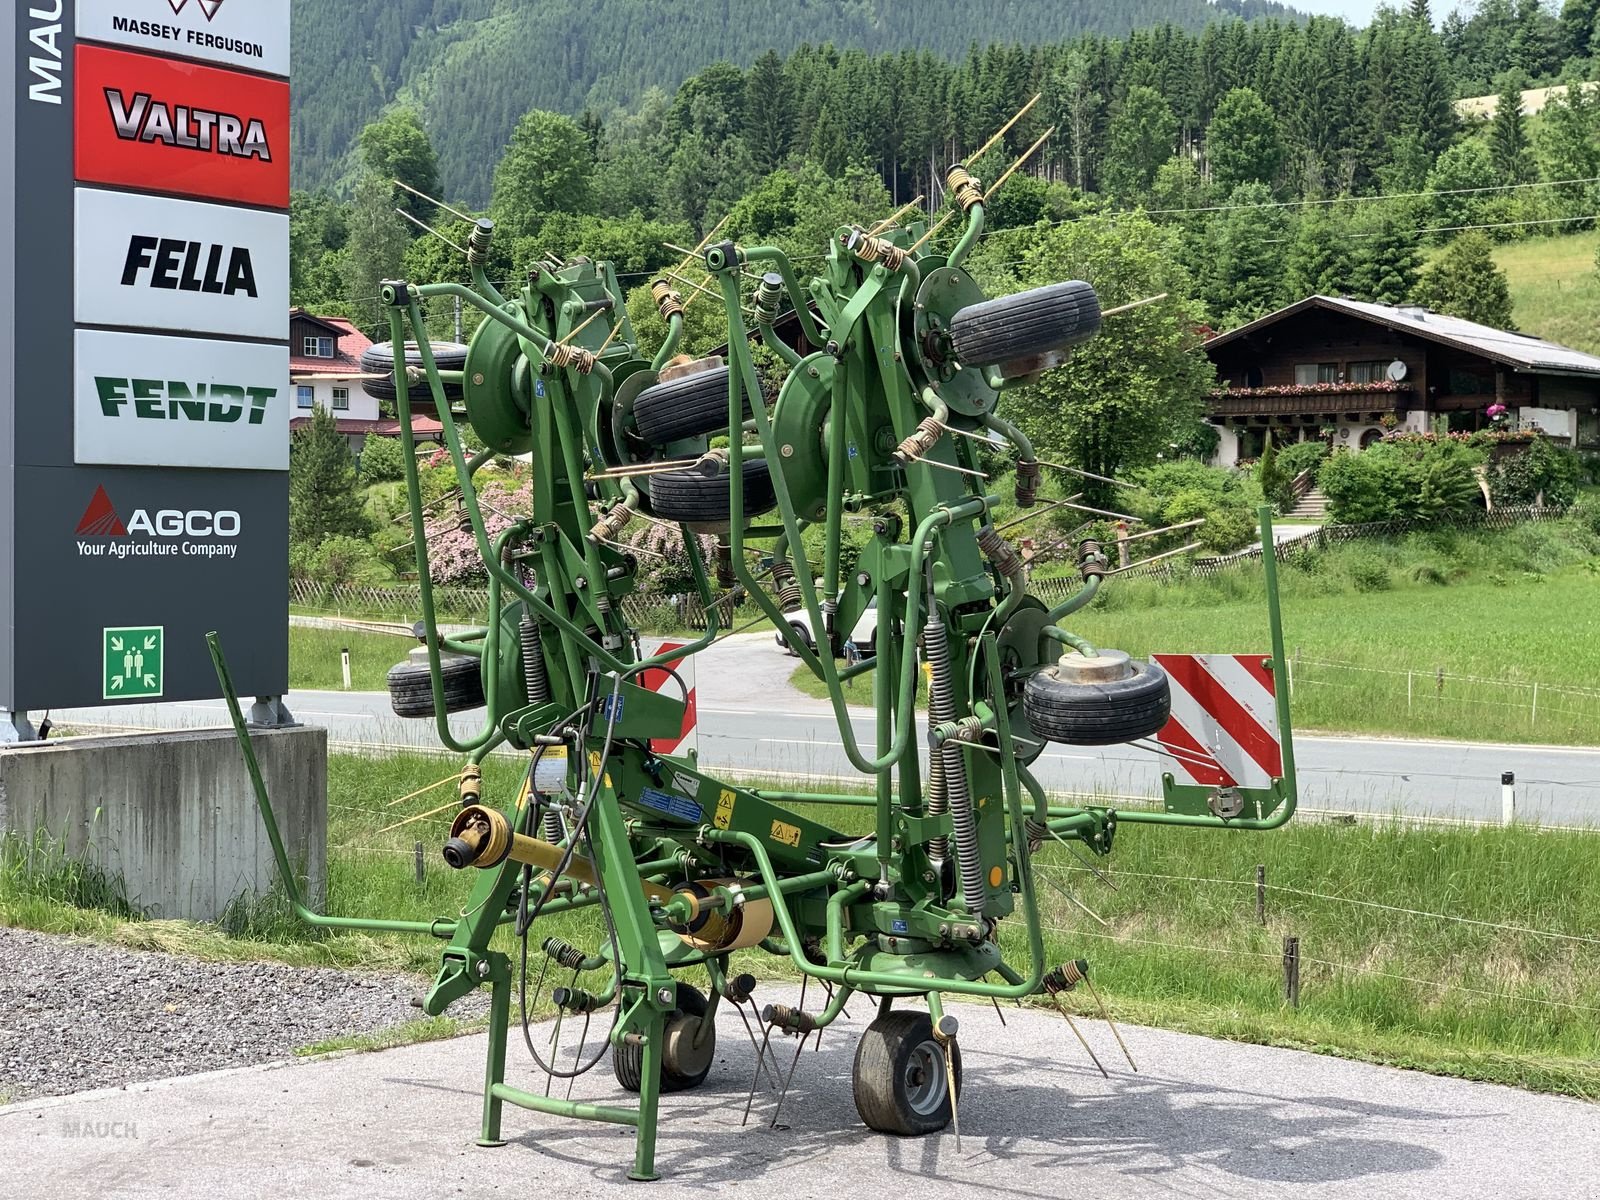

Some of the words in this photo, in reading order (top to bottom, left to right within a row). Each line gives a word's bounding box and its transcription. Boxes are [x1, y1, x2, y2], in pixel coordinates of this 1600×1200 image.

[113, 16, 181, 41] MASSEY
[187, 30, 263, 57] FERGUSON
[103, 87, 272, 163] VALTRA
[120, 235, 258, 298] FELLA
[94, 376, 278, 424] FENDT
[127, 509, 241, 537] AGCO
[77, 541, 105, 556] Your
[108, 541, 178, 558] Agriculture
[182, 541, 237, 558] Company
